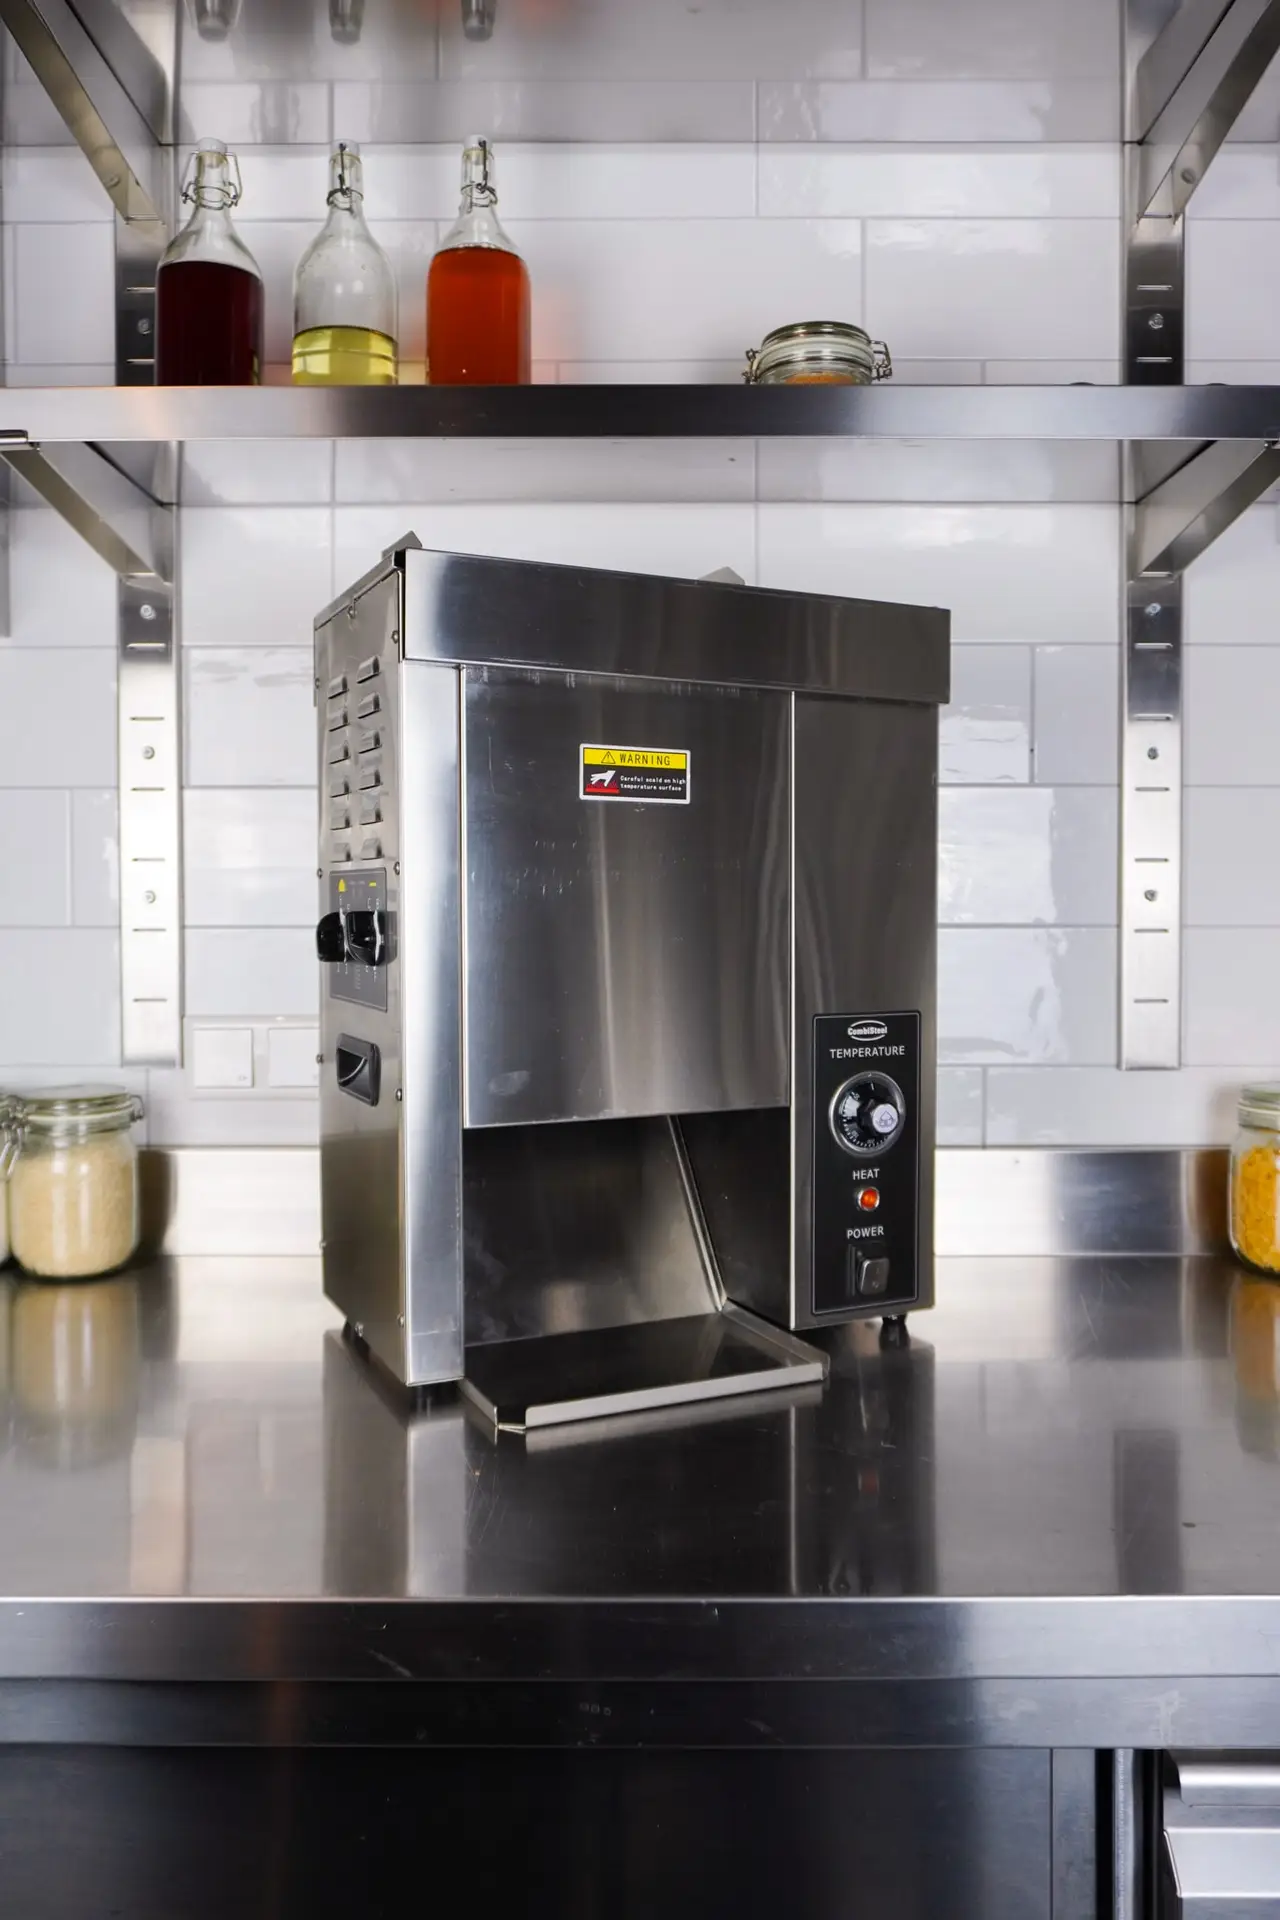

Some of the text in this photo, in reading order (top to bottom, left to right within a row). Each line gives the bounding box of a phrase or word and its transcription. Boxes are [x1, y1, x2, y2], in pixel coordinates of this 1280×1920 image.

[620, 753, 670, 766] WARNING
[847, 1026, 888, 1036] CombiSteel
[829, 1045, 905, 1059] TEMPERATURE
[852, 1168, 880, 1180] HEAT
[846, 1226, 885, 1239] POWER
